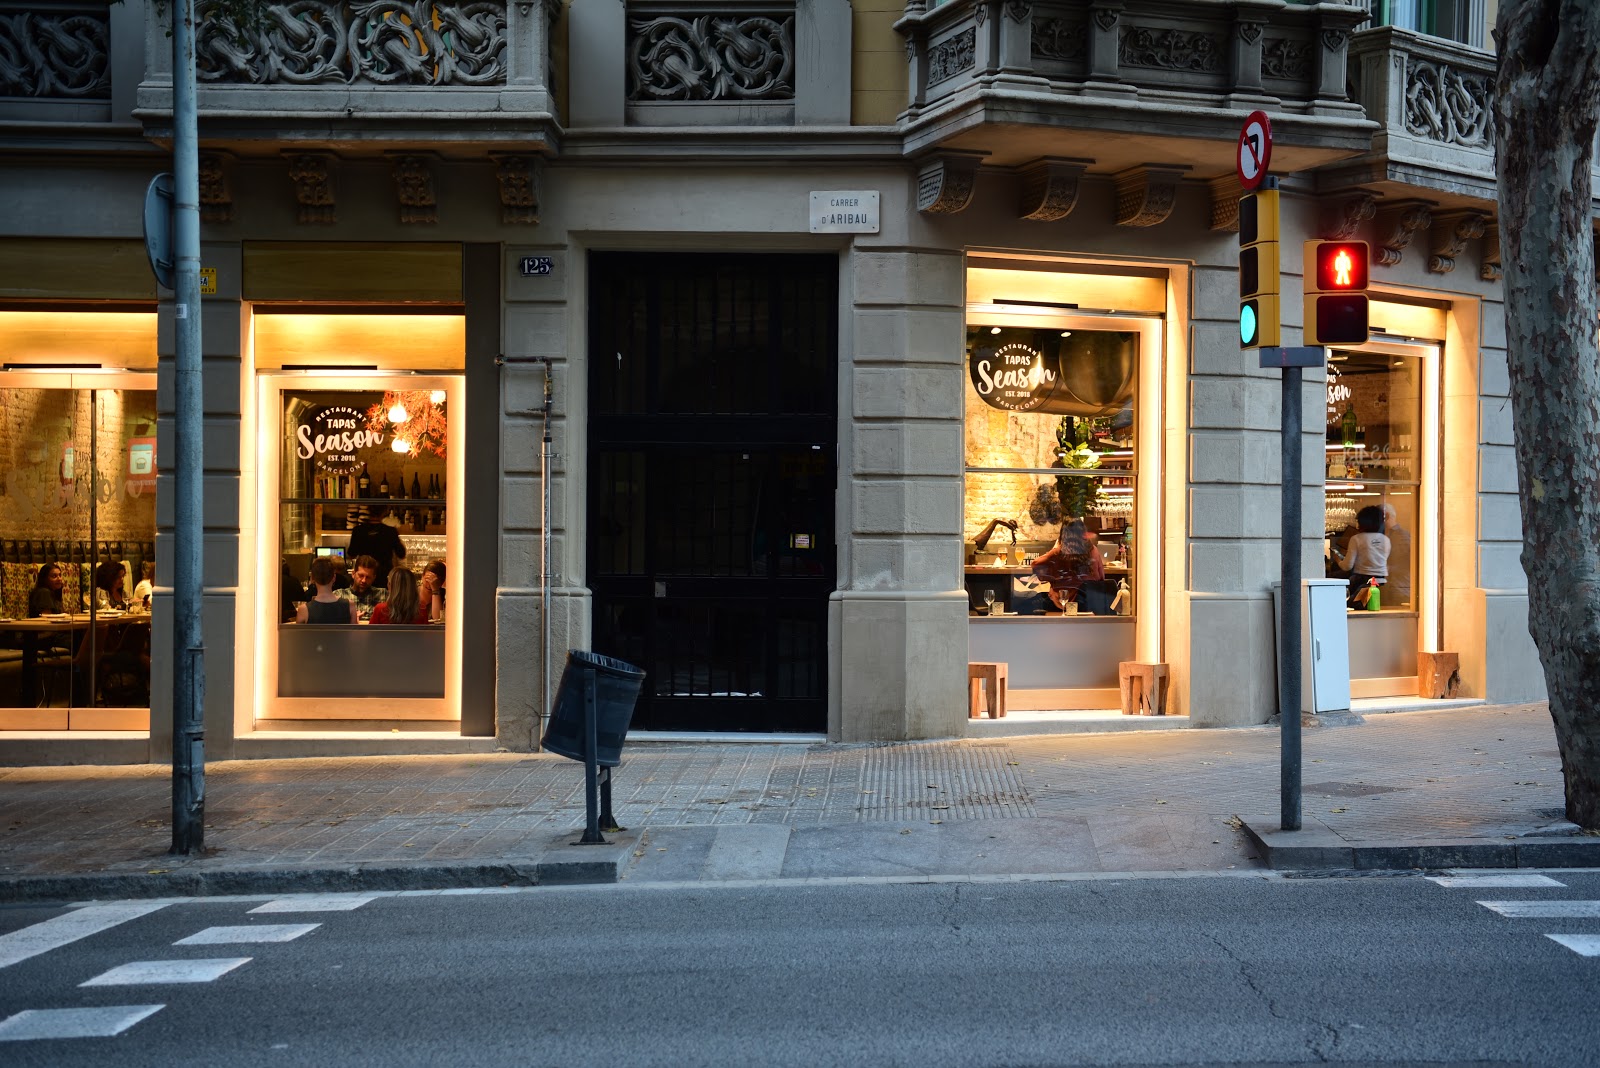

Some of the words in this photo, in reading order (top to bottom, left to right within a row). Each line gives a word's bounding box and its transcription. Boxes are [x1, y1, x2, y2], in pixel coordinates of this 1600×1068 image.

[831, 198, 859, 207] CARRER
[523, 258, 550, 273] 125
[994, 343, 1040, 359] RESTAURANT
[1004, 355, 1031, 366] TAPAS
[977, 360, 1056, 394] Season
[1326, 374, 1337, 384] PAS
[1017, 390, 1031, 398] 2018
[1326, 384, 1352, 404] son
[995, 396, 1039, 410] BARCELONA
[315, 406, 367, 422] RESTAURANT
[326, 418, 356, 429] TAPAS
[297, 424, 385, 460] Season
[327, 454, 339, 462] EST.
[340, 454, 356, 462] 2018
[316, 460, 366, 475] BARCELONA
